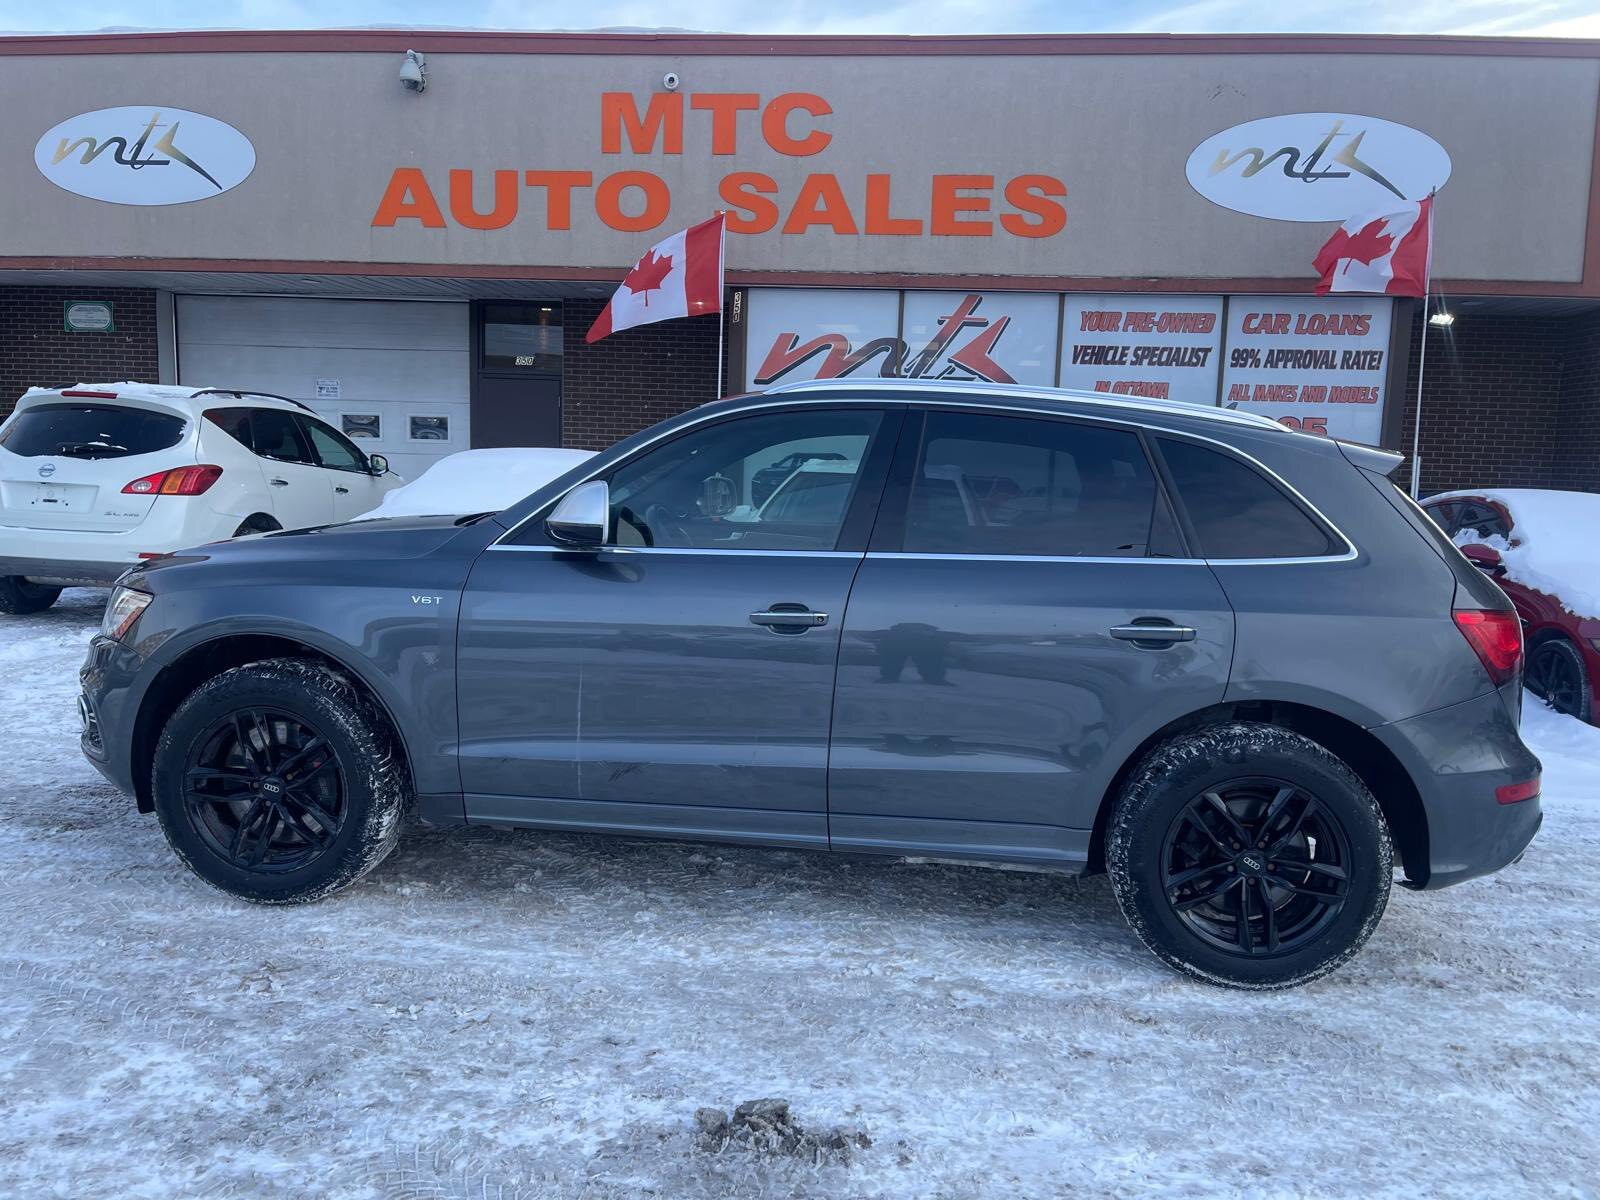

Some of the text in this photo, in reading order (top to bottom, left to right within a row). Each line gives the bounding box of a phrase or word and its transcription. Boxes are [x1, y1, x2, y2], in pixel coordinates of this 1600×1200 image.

[601, 91, 833, 157] MTC
[371, 167, 1068, 239] AUTO SALES
[733, 291, 742, 323] 350
[1080, 311, 1217, 334] YOUR PRE-OWNED
[1241, 313, 1372, 336] CAR LOANS
[1071, 344, 1213, 368] VEHICLE SPECIALIST
[1230, 348, 1384, 371] 99% APPROVAL RATE!
[1112, 380, 1170, 400] OTTAWA
[1228, 383, 1379, 404] ALL MAKES AND MODELS
